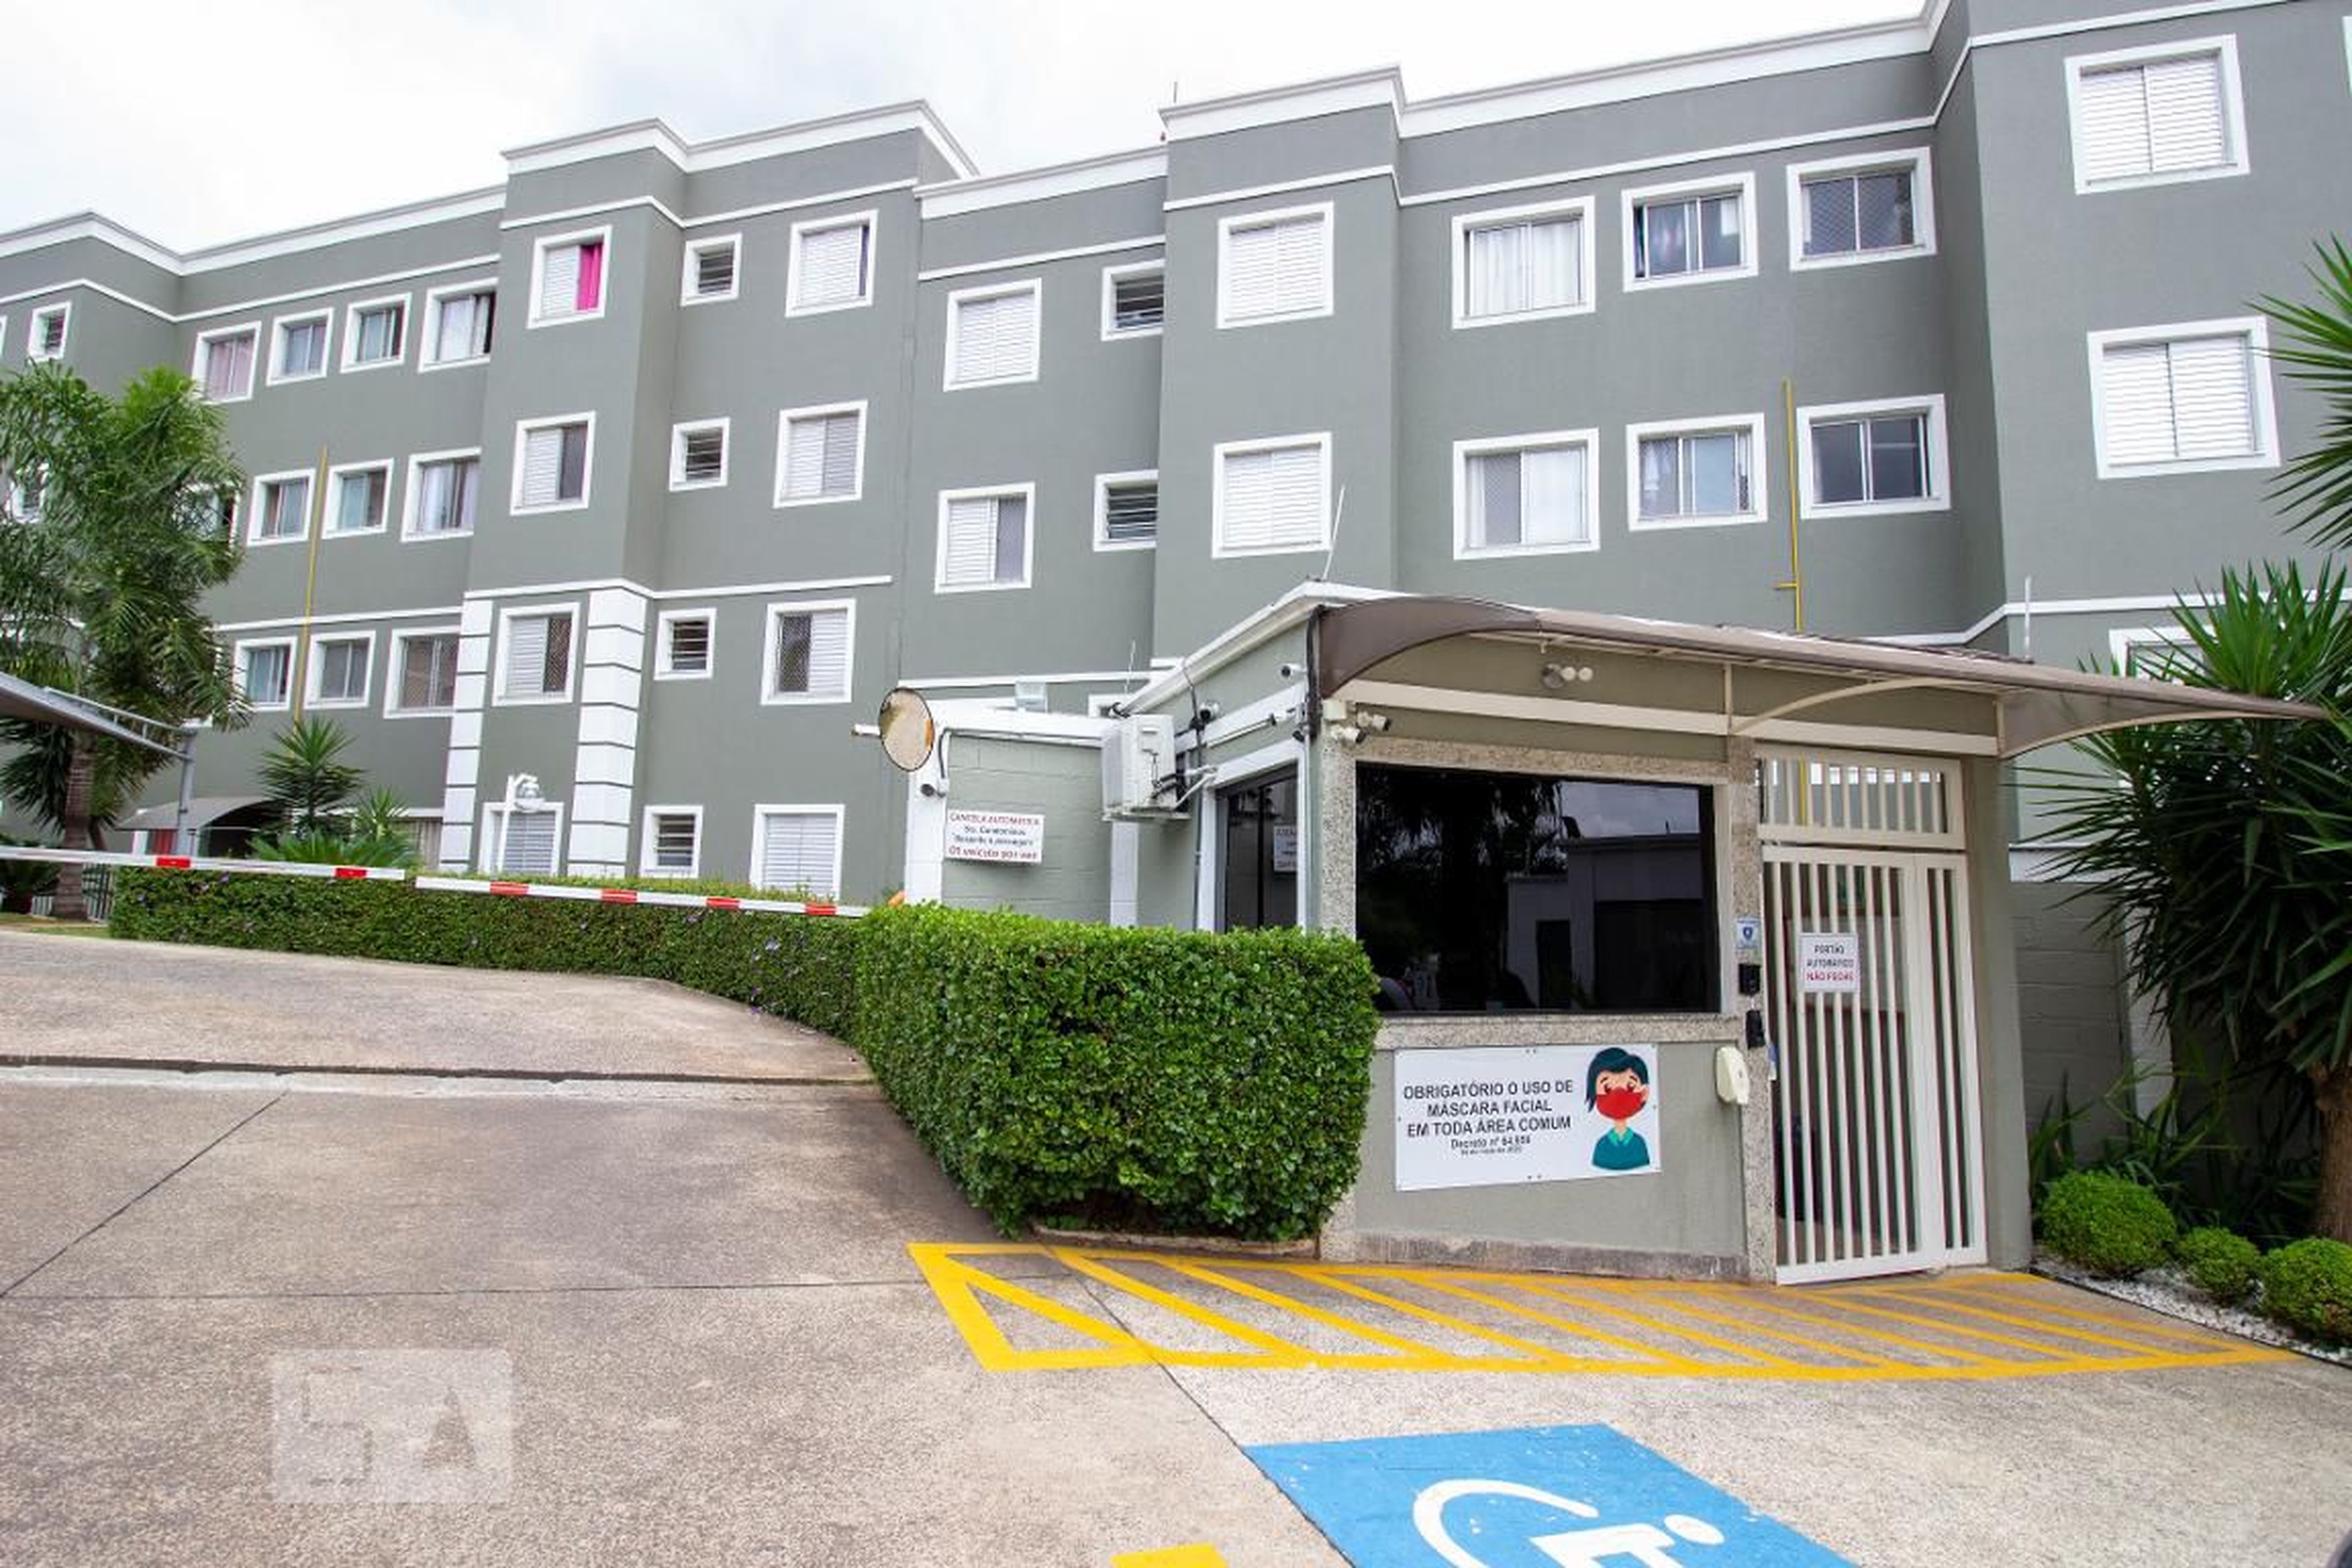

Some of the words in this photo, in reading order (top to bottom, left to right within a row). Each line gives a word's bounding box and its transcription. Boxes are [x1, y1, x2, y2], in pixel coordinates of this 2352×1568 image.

[1403, 1082, 1504, 1099] OBRIGATÓRIO
[1507, 1082, 1518, 1095] O
[1522, 1080, 1551, 1095] USO
[1555, 1079, 1574, 1093] DE
[1503, 1099, 1553, 1115] FACIAL
[1408, 1123, 1430, 1137] EM
[1432, 1120, 1472, 1137] TODA
[1518, 1115, 1572, 1132] COMUM
[1451, 1139, 1487, 1149] Decreto
